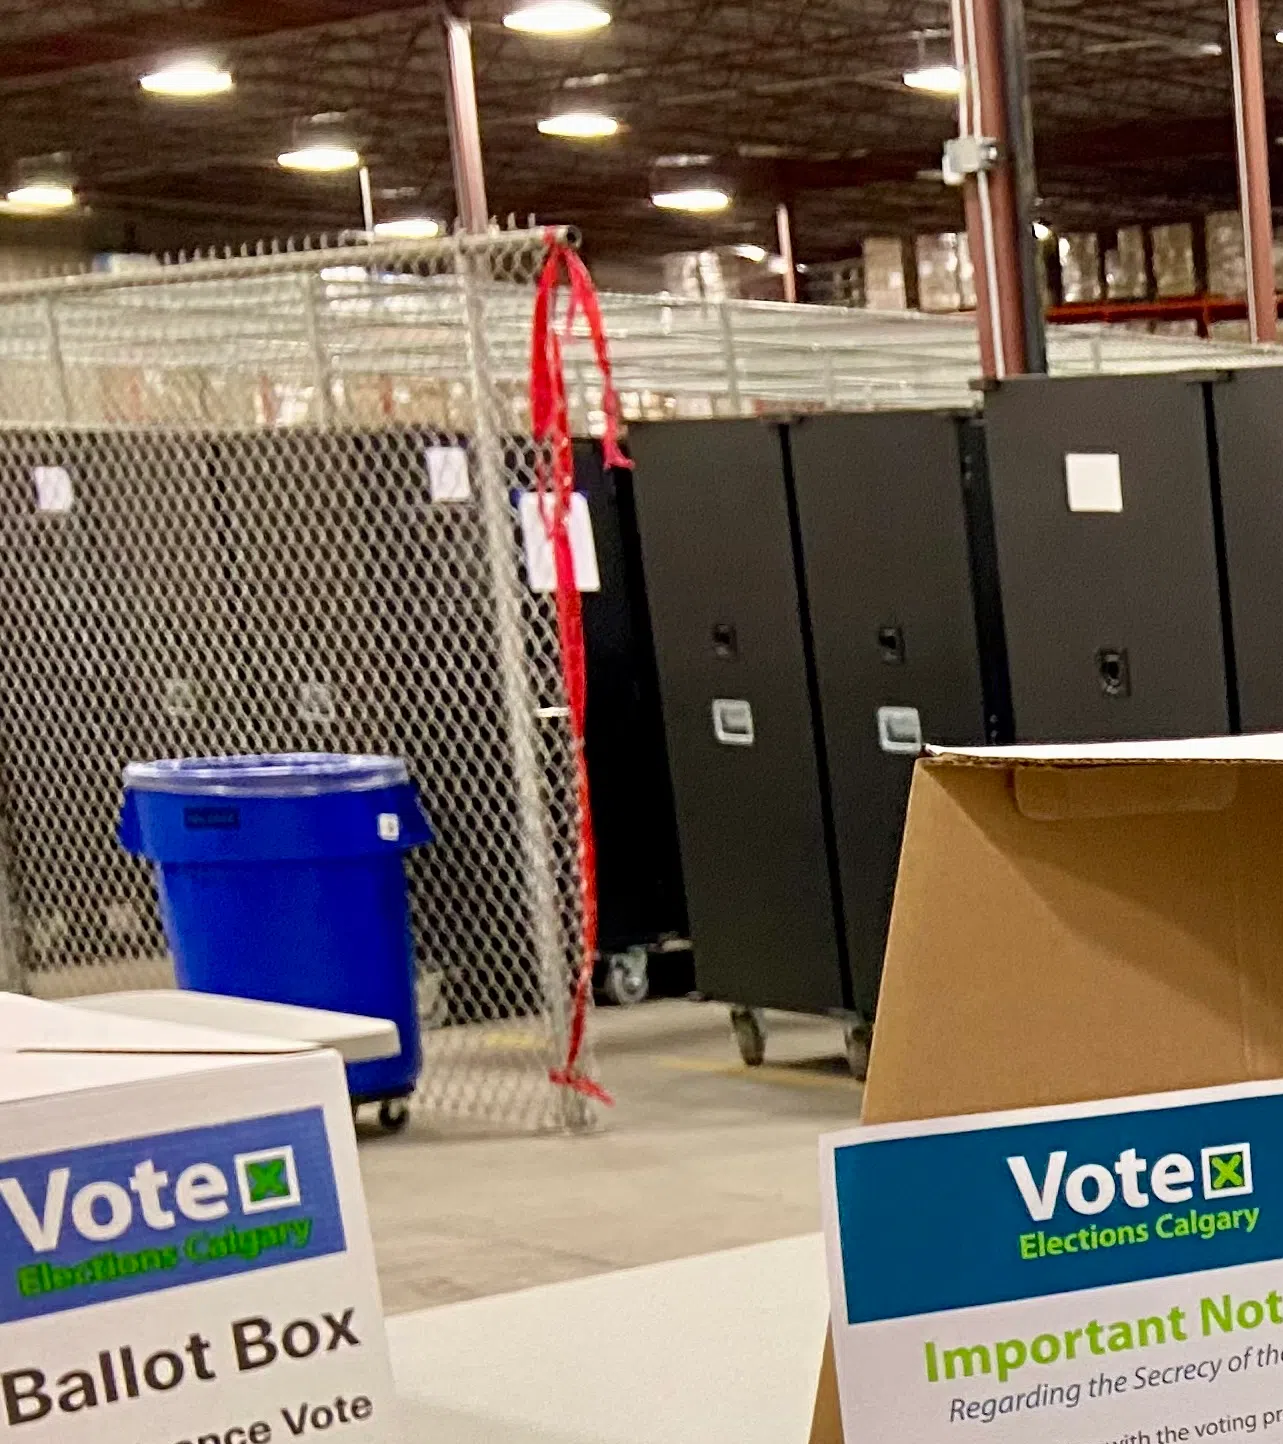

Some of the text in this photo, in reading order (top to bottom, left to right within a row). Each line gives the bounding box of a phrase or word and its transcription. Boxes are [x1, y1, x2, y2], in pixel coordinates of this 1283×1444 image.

[0, 1152, 229, 1253] Vote
[1006, 1147, 1195, 1222] Vote
[18, 1216, 312, 1298] Elections Calgary
[1018, 1206, 1260, 1260] Elections Calgary
[1, 1306, 361, 1426] Ballot Box
[923, 1305, 1188, 1383] Important
[281, 1389, 374, 1437] Vote
[948, 1382, 1081, 1424] Regarding
[1087, 1371, 1128, 1398] the
[1132, 1357, 1223, 1390] Secrecy
[1227, 1345, 1254, 1373] of
[1193, 1413, 1257, 1438] voting
